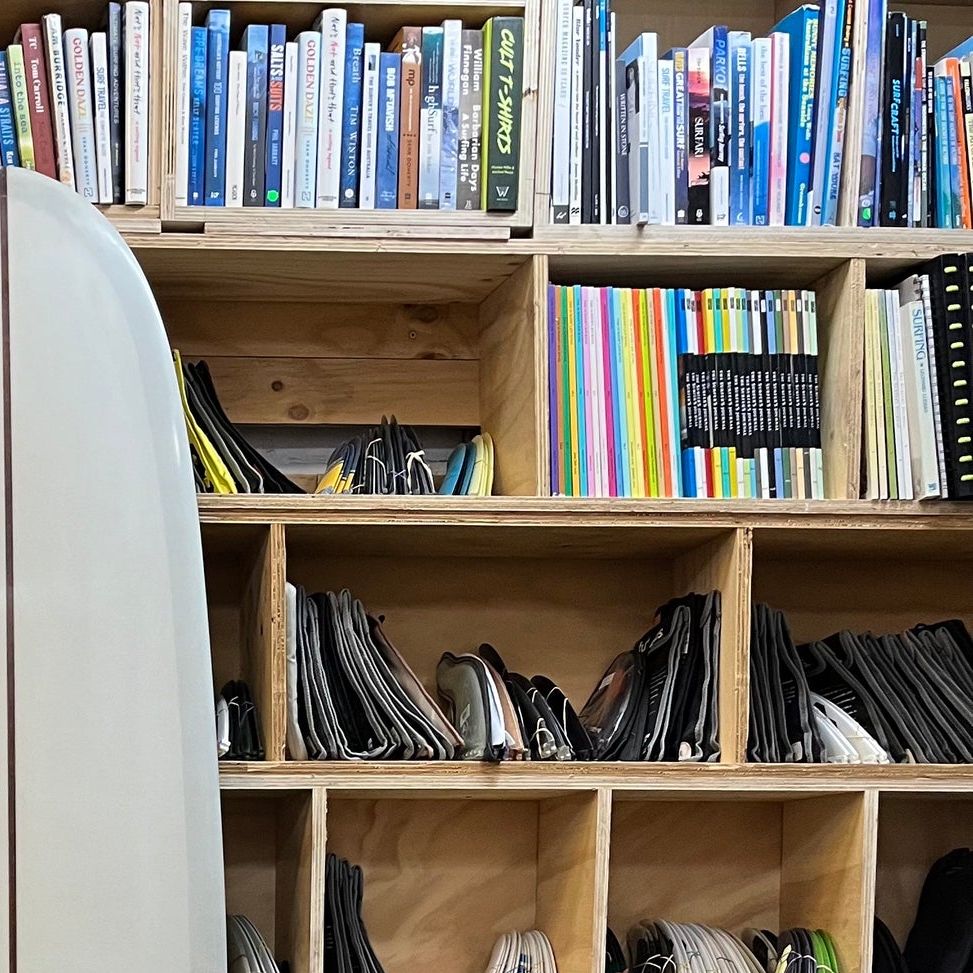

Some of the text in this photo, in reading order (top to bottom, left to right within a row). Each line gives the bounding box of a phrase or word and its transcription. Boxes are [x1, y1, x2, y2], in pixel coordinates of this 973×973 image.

[29, 37, 37, 49] TC
[498, 29, 515, 73] CULT
[715, 39, 725, 84] PARKO
[737, 47, 747, 72] BELLS
[31, 58, 40, 79] Tom
[53, 50, 64, 106] BURRIDGE
[73, 38, 88, 120] GOLDEN DAZE
[97, 67, 106, 111] SURF TRAVEL
[214, 82, 222, 94] 100
[269, 44, 284, 111] SALTS SUITS
[305, 40, 316, 124] GOLDEN DAZE
[386, 68, 395, 86] BOB
[406, 69, 415, 86] mp
[461, 45, 482, 95] William Finnegan
[662, 68, 671, 114] SURF TRAVEL
[838, 48, 851, 97] SURFING
[14, 62, 28, 134] into the sea
[33, 79, 44, 113] Carroll
[347, 48, 362, 176] Breath TIM WINTON
[497, 75, 513, 154] T-SHIRTS
[676, 72, 685, 149] GREAT SURF
[890, 79, 901, 135] SURFCRAFT
[459, 113, 469, 182] A Surfing Life
[469, 104, 481, 192] Barbarian Days
[694, 117, 703, 158] SURFARI
[913, 309, 927, 361] SURFING
